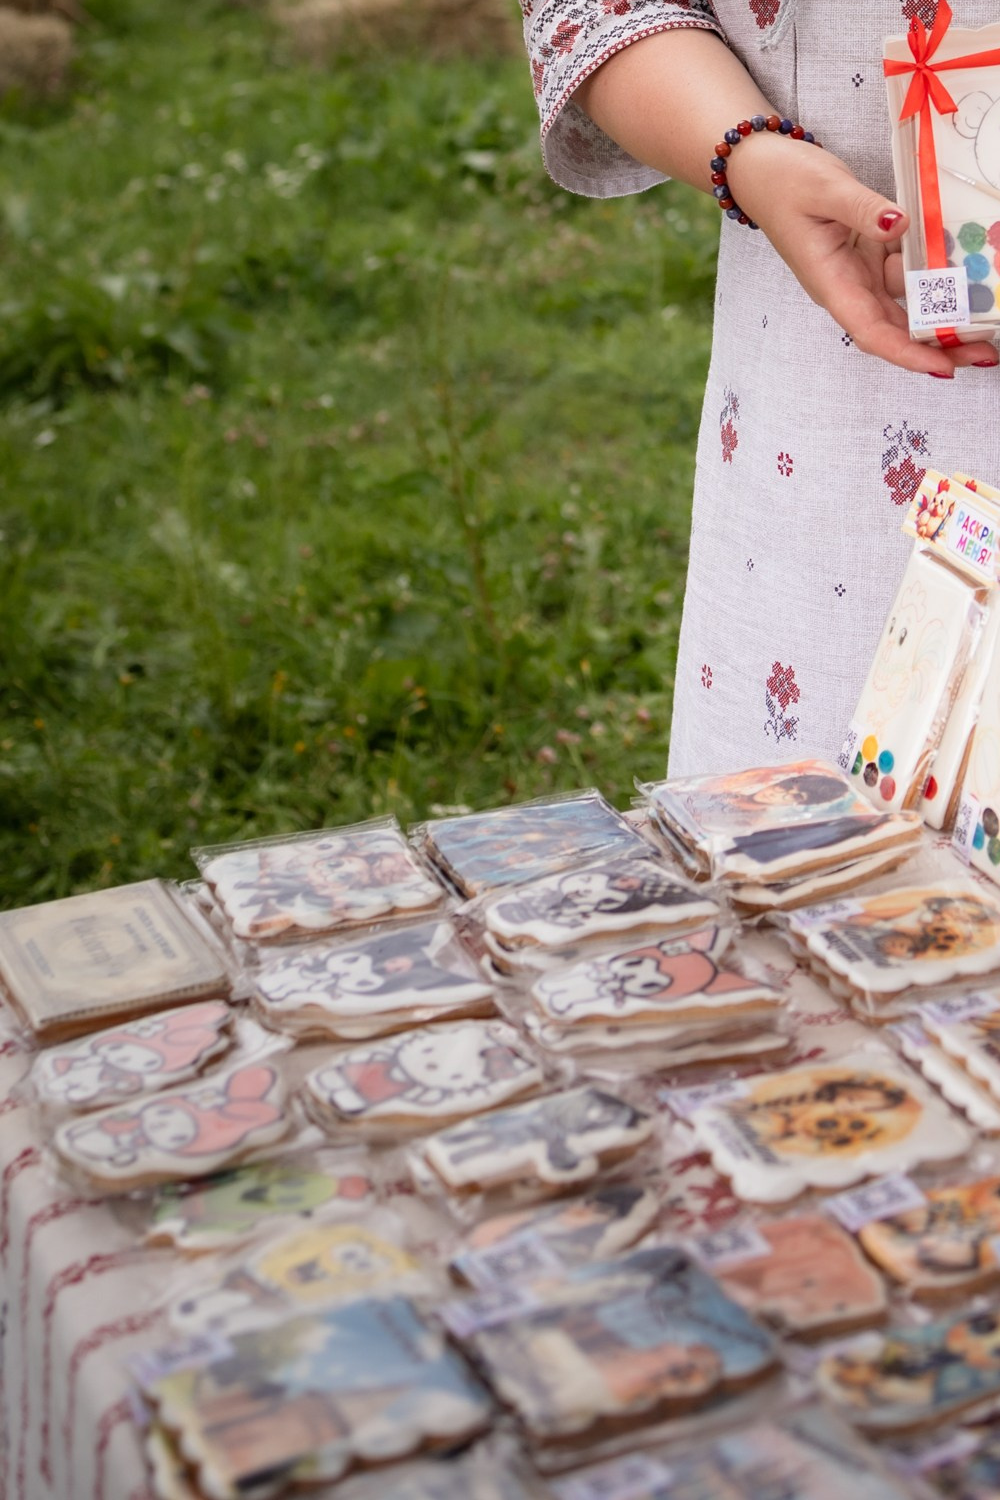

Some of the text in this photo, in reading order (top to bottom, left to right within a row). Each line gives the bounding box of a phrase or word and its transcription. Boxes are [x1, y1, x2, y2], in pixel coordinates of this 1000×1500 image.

[921, 316, 966, 326] Lanachokocake
[956, 510, 995, 548] РАСКРА
[956, 534, 992, 567] МЕНЯ!
